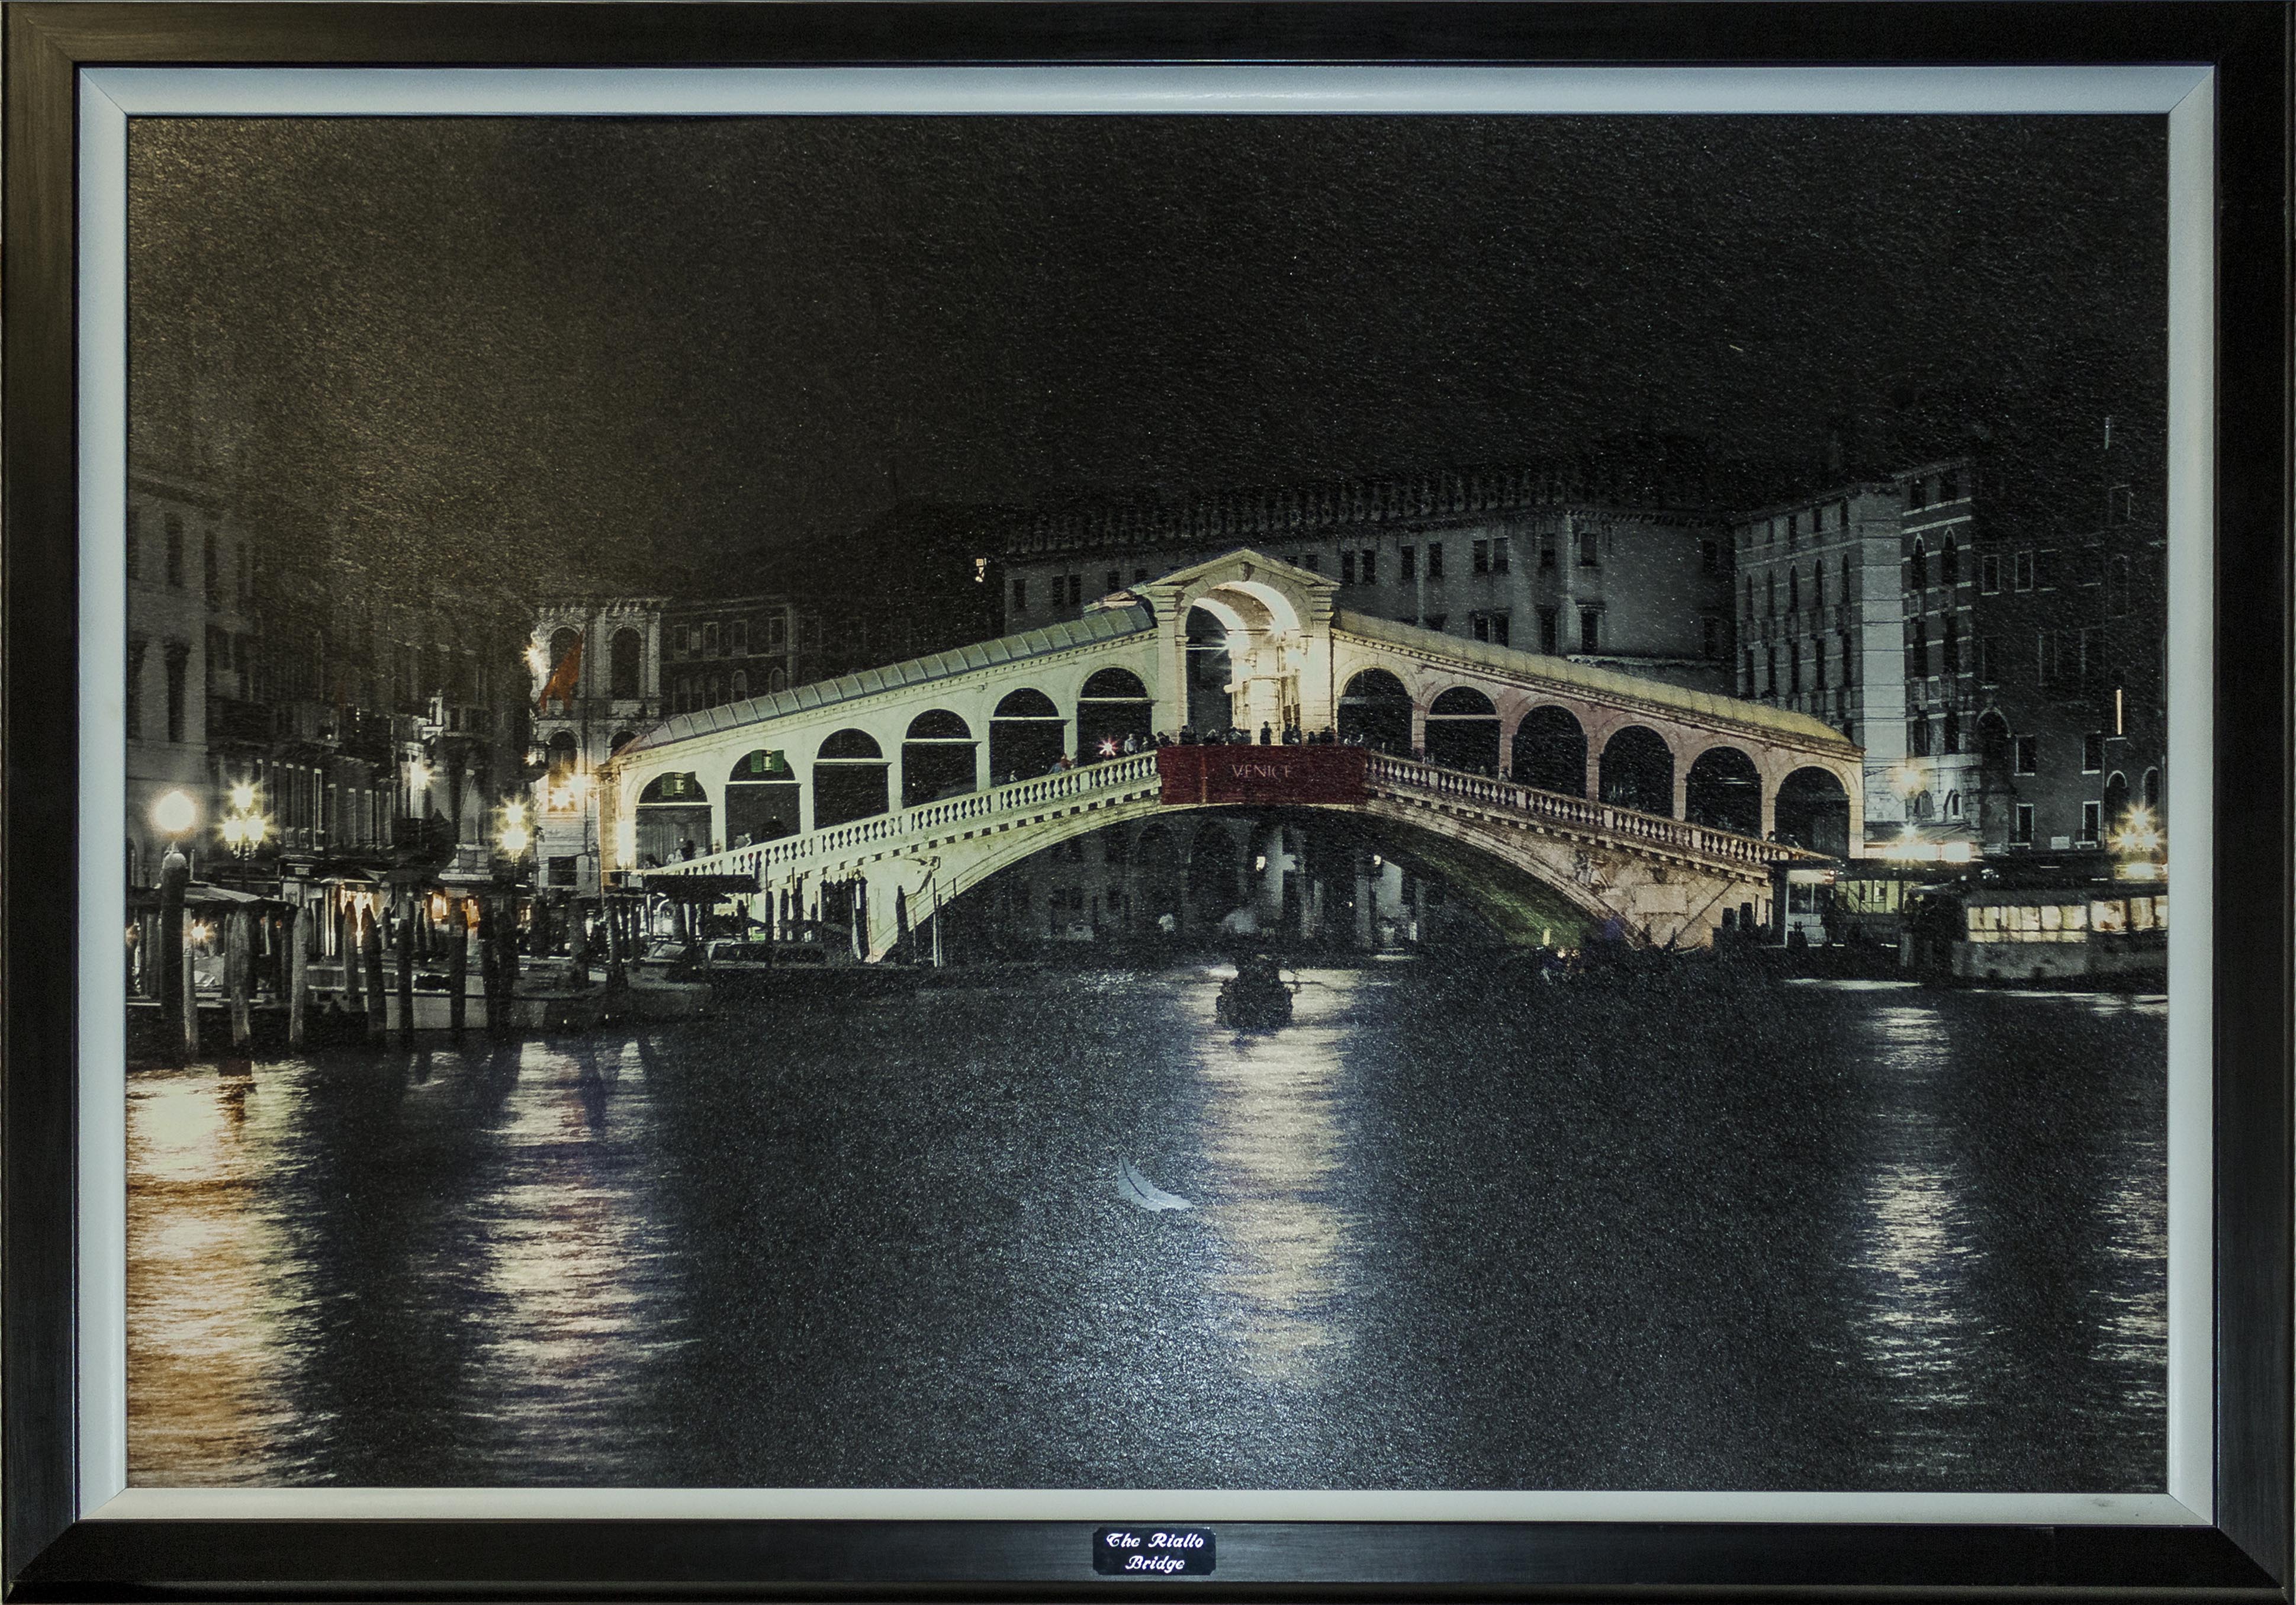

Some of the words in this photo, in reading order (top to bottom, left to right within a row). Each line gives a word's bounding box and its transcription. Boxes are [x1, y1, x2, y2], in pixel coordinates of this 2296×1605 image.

[1232, 764, 1292, 779] VENICE
[1106, 1533, 1140, 1548] The
[1148, 1532, 1204, 1548] Rialto
[1125, 1555, 1185, 1574] Bridge
